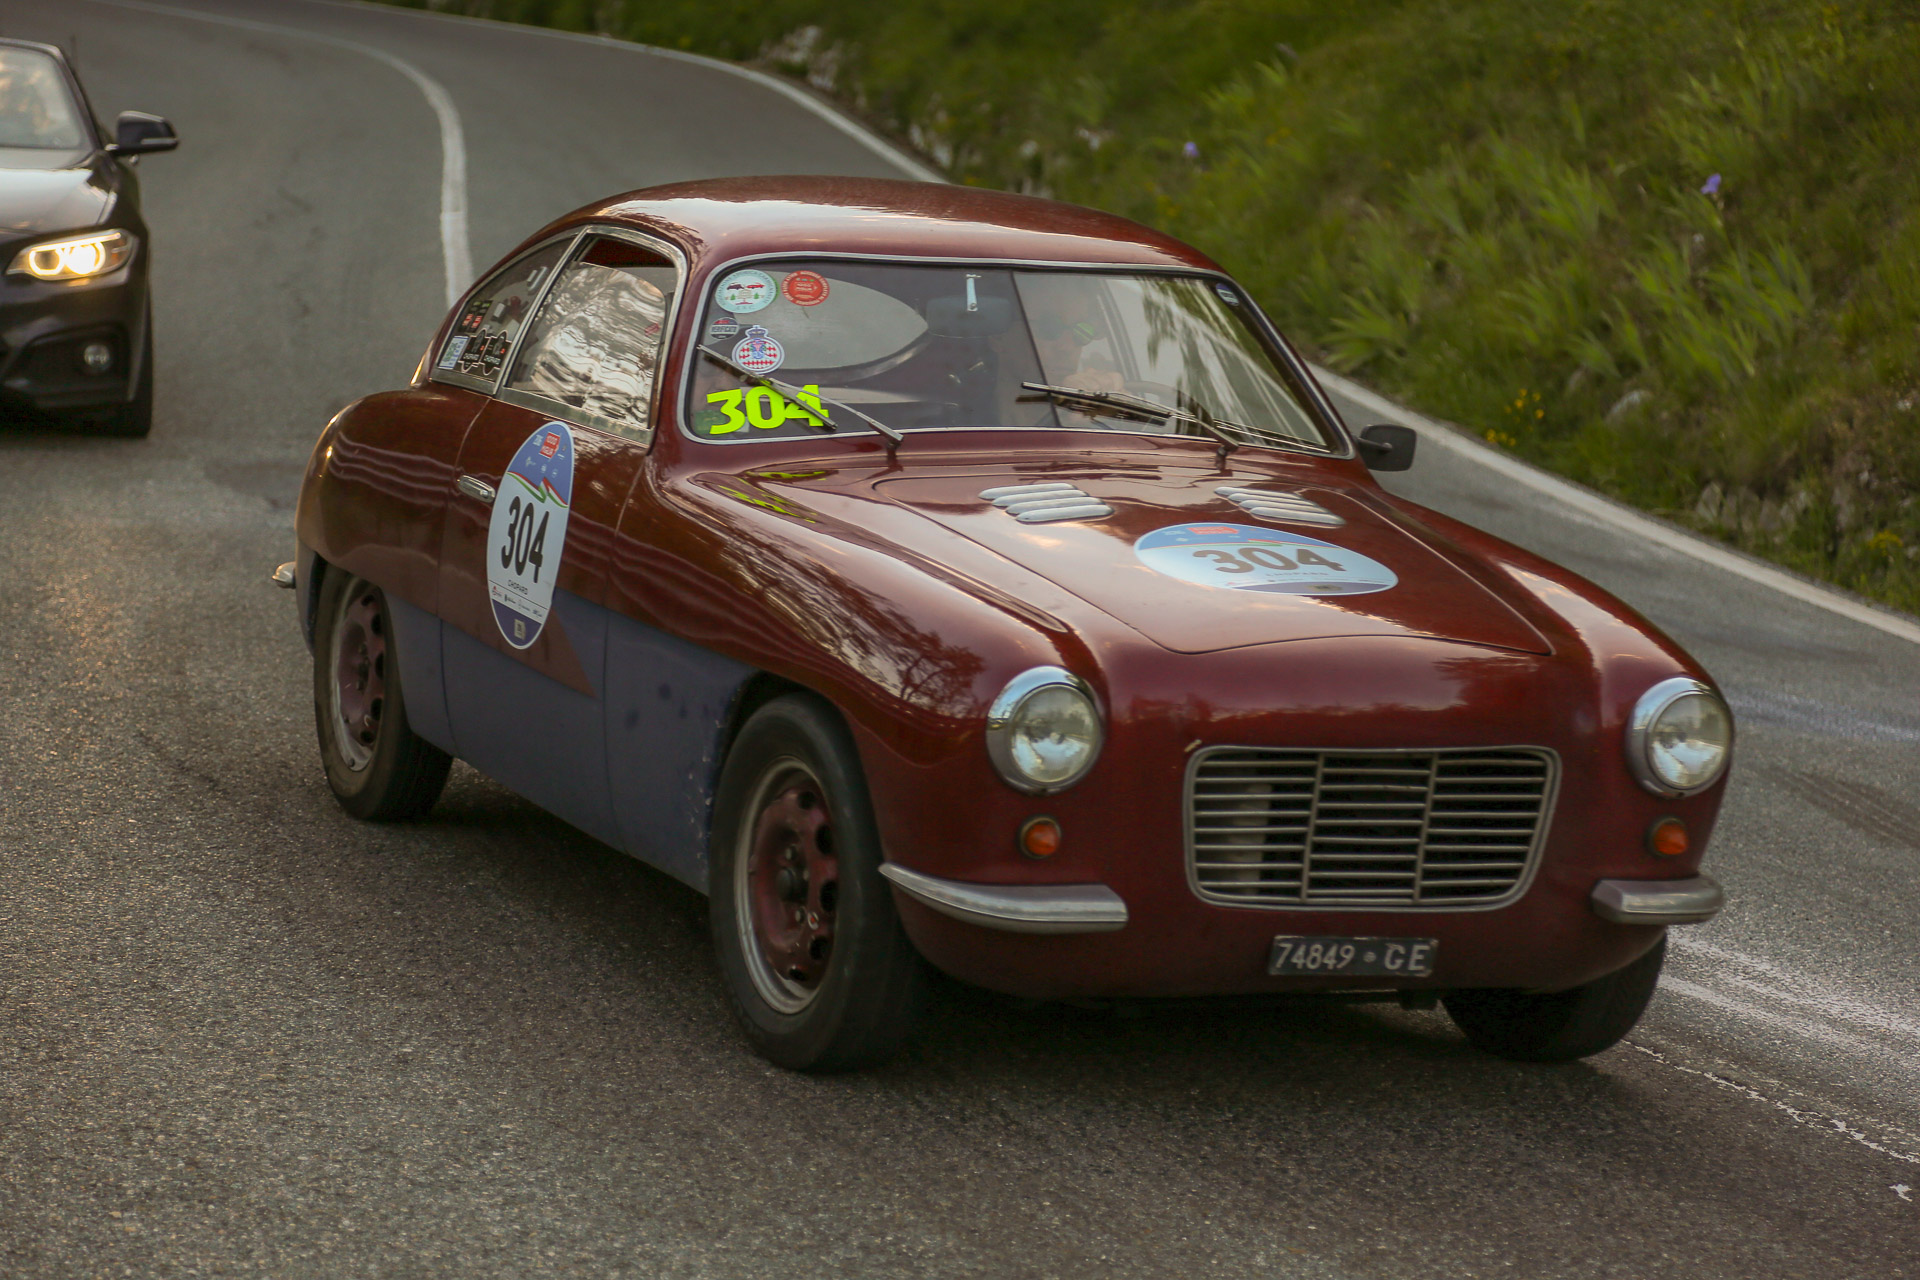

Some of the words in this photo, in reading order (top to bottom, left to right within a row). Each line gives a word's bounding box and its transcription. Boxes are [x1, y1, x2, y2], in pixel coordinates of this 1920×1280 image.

[707, 384, 830, 435] 304
[501, 496, 550, 584] 304
[1192, 547, 1347, 574] 304
[1275, 943, 1356, 970] 74849
